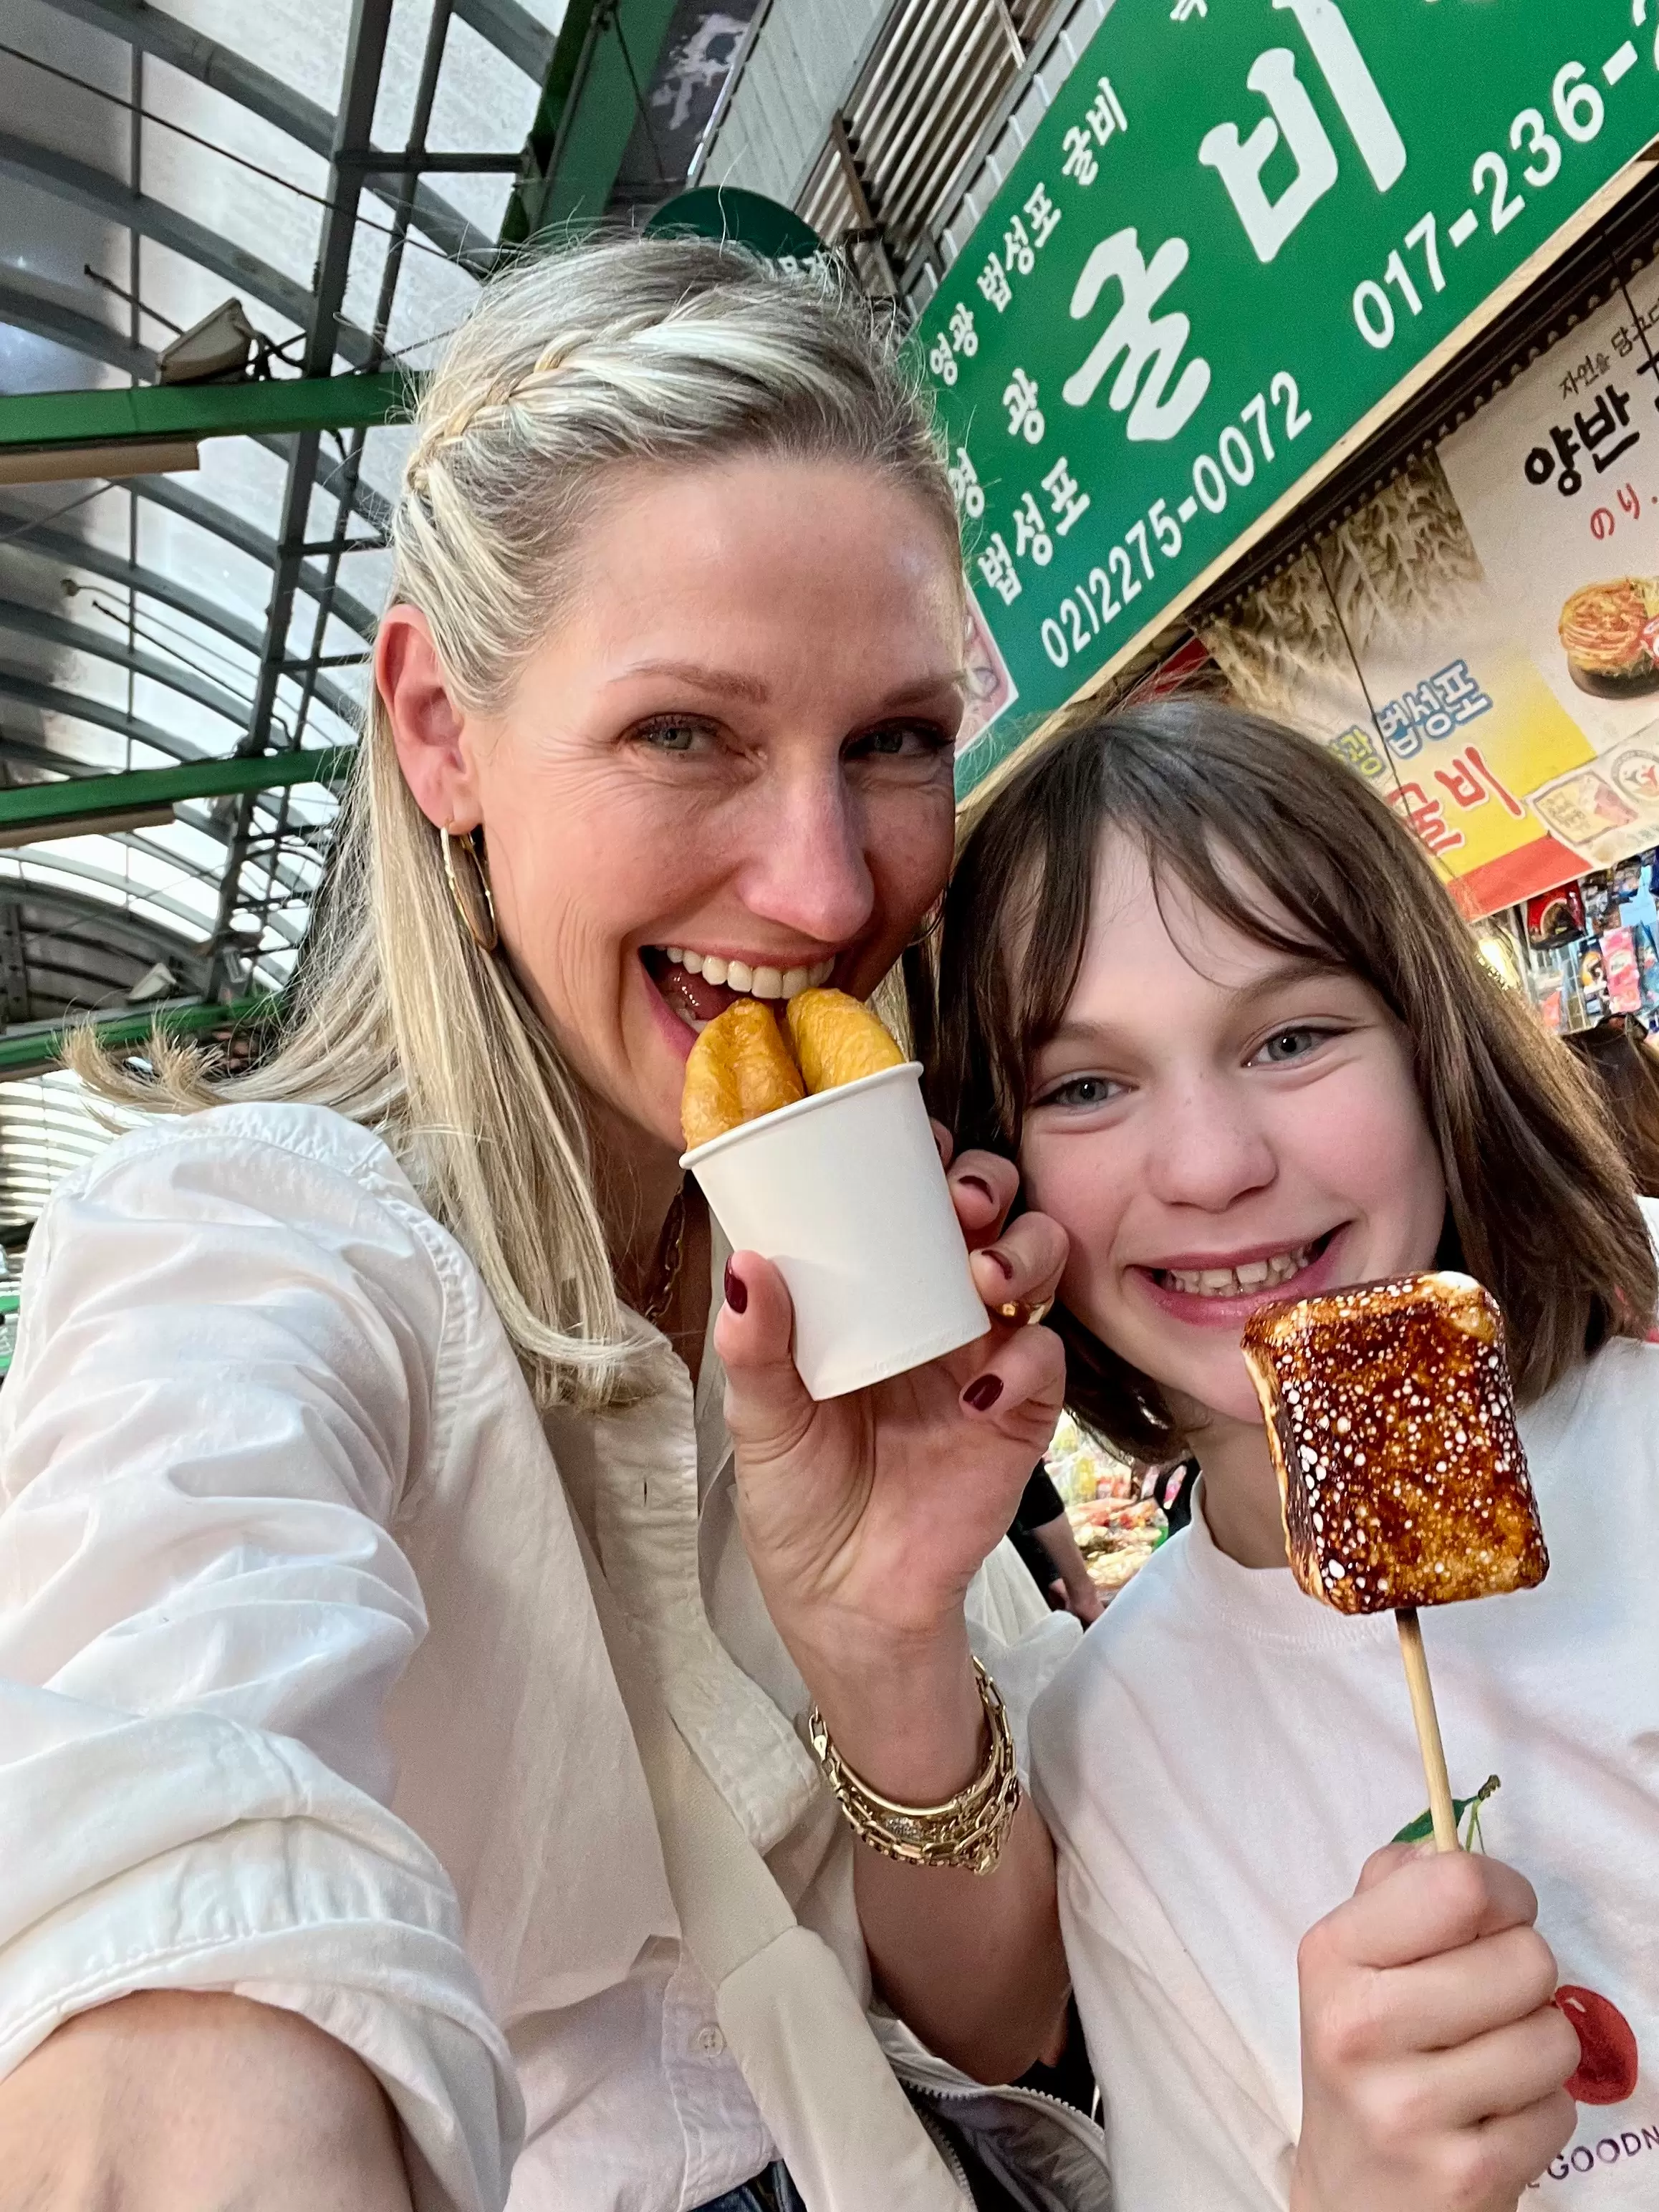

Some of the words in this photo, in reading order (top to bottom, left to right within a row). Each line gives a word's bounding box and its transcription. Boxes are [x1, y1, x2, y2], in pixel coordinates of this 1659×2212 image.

[930, 302, 979, 385] 영광
[976, 181, 1062, 313] 법성포
[1062, 77, 1128, 186] 굴비
[1062, 0, 1407, 441] 굴비
[1352, 0, 1659, 350] 017-236-
[977, 456, 1091, 606] 법성포
[1524, 383, 1641, 497] 양반
[1375, 659, 1494, 760] 법성포
